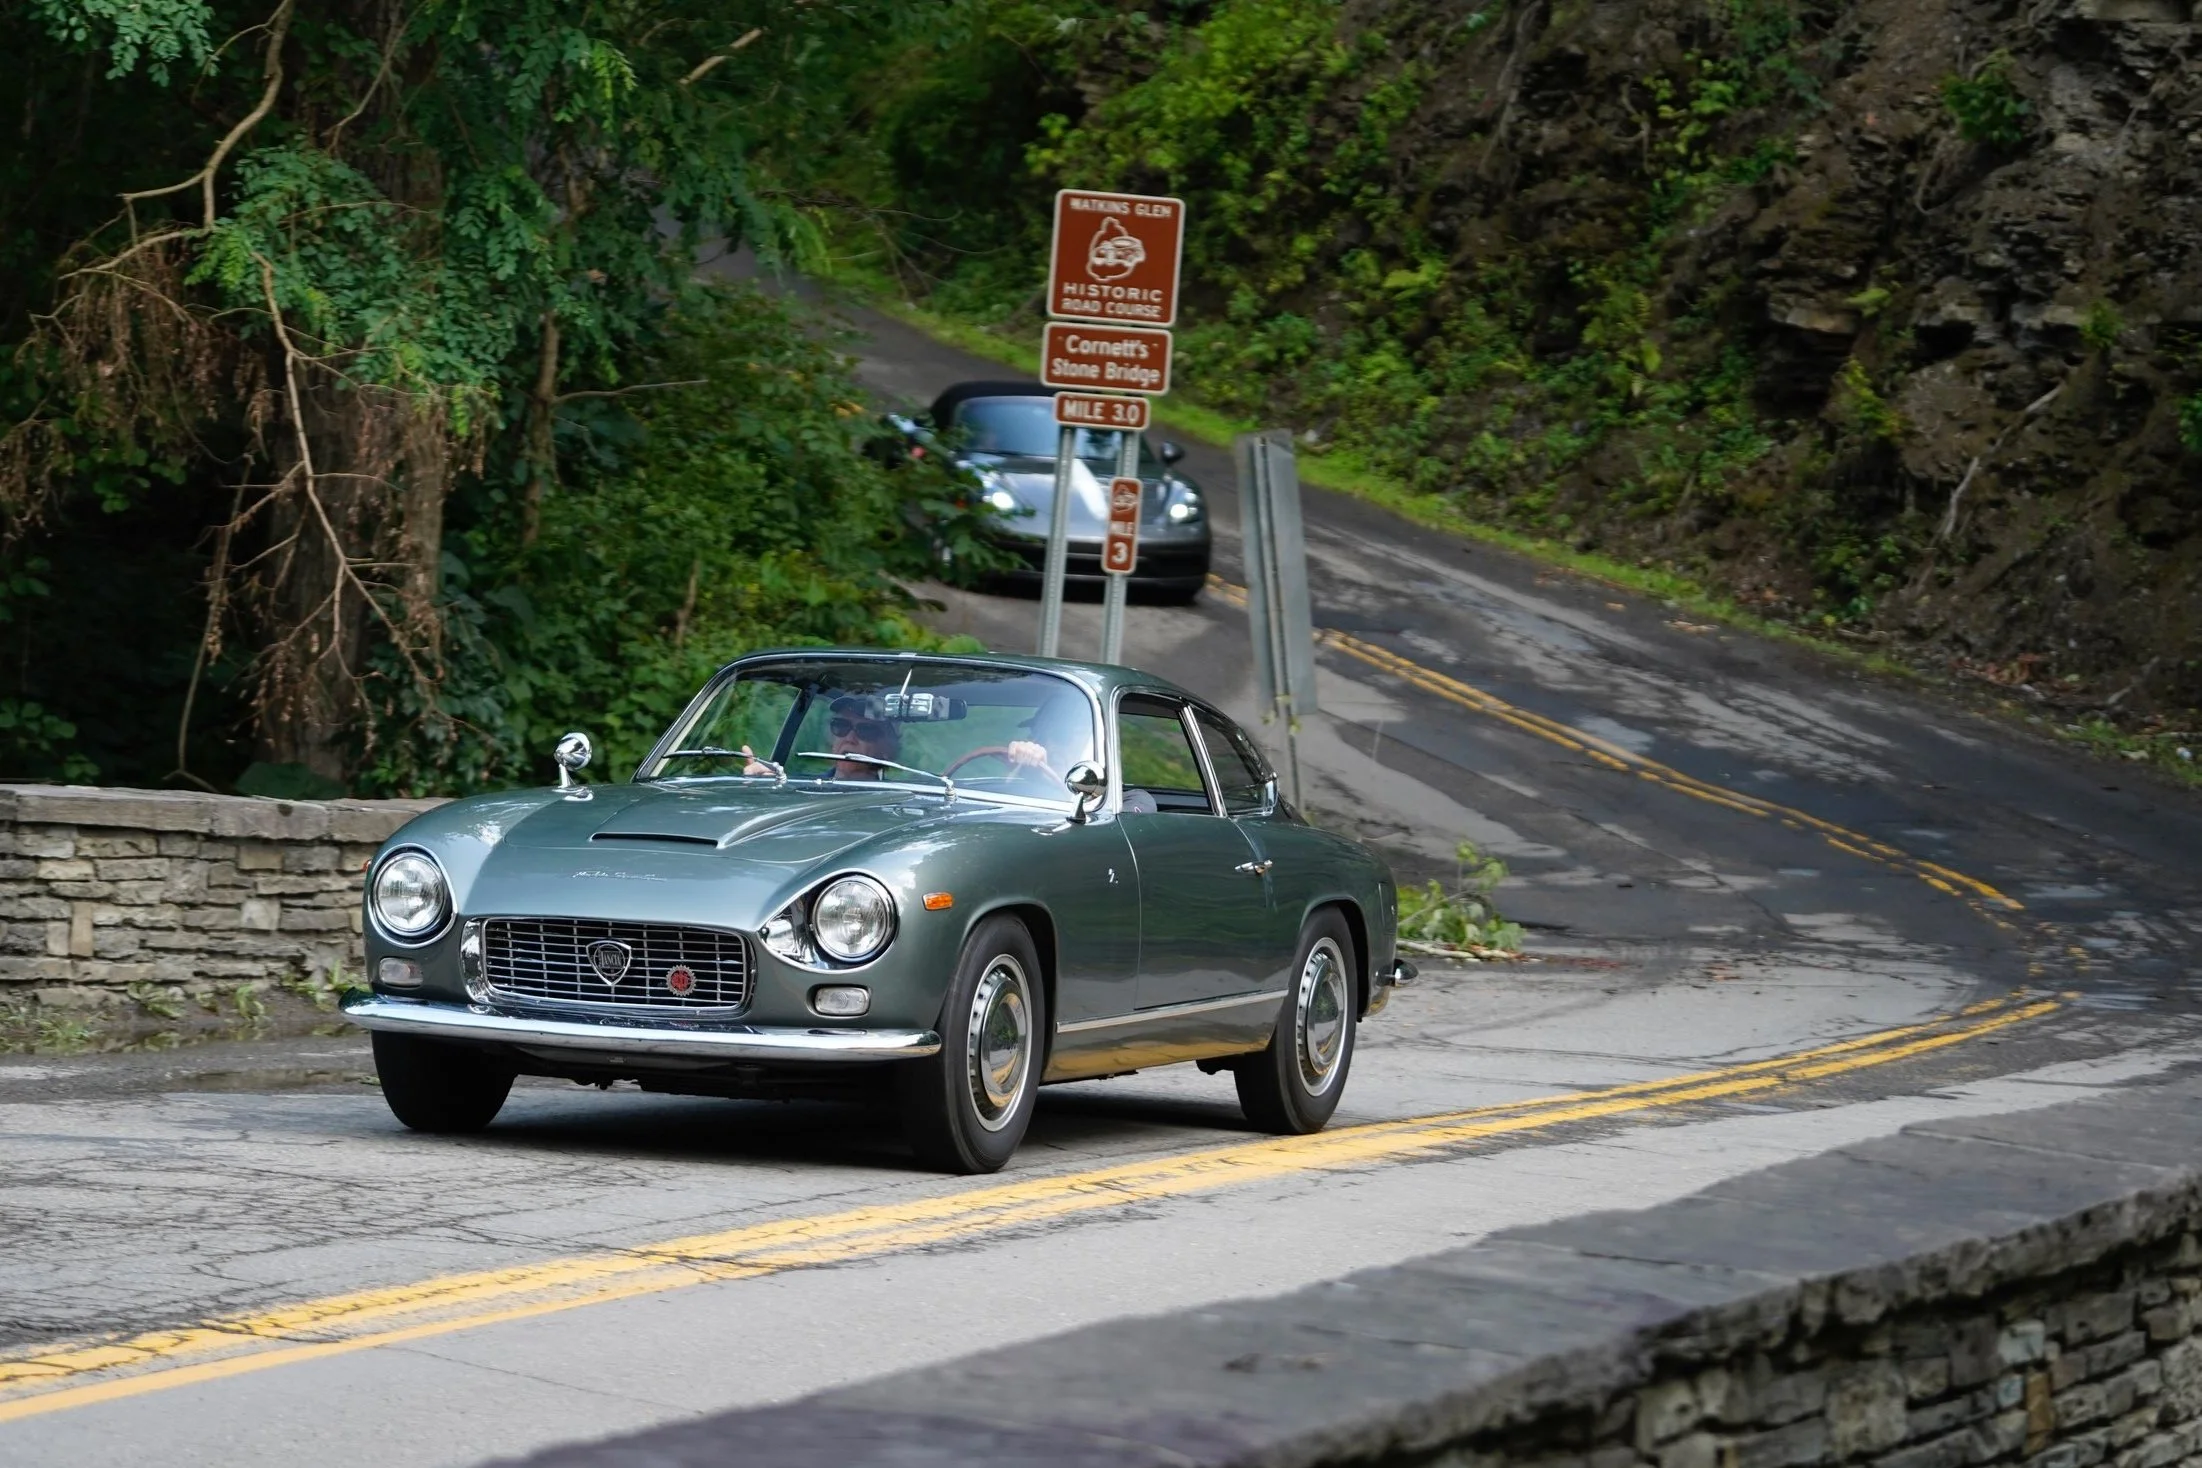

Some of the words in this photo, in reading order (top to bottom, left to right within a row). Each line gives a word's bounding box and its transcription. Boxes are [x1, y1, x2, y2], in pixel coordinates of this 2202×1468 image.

[1069, 198, 1130, 215] WATKINS
[1134, 203, 1172, 217] GLEN
[1063, 282, 1163, 302] HISTORIC
[1061, 298, 1101, 313] ROAD
[1104, 301, 1162, 317] COURSE
[1065, 334, 1149, 359] Cornett's
[1051, 357, 1100, 378] Stone
[1104, 361, 1161, 388] Bridge
[1063, 399, 1105, 420] MILE
[1112, 403, 1140, 424] 3.0
[1111, 541, 1128, 564] 3
